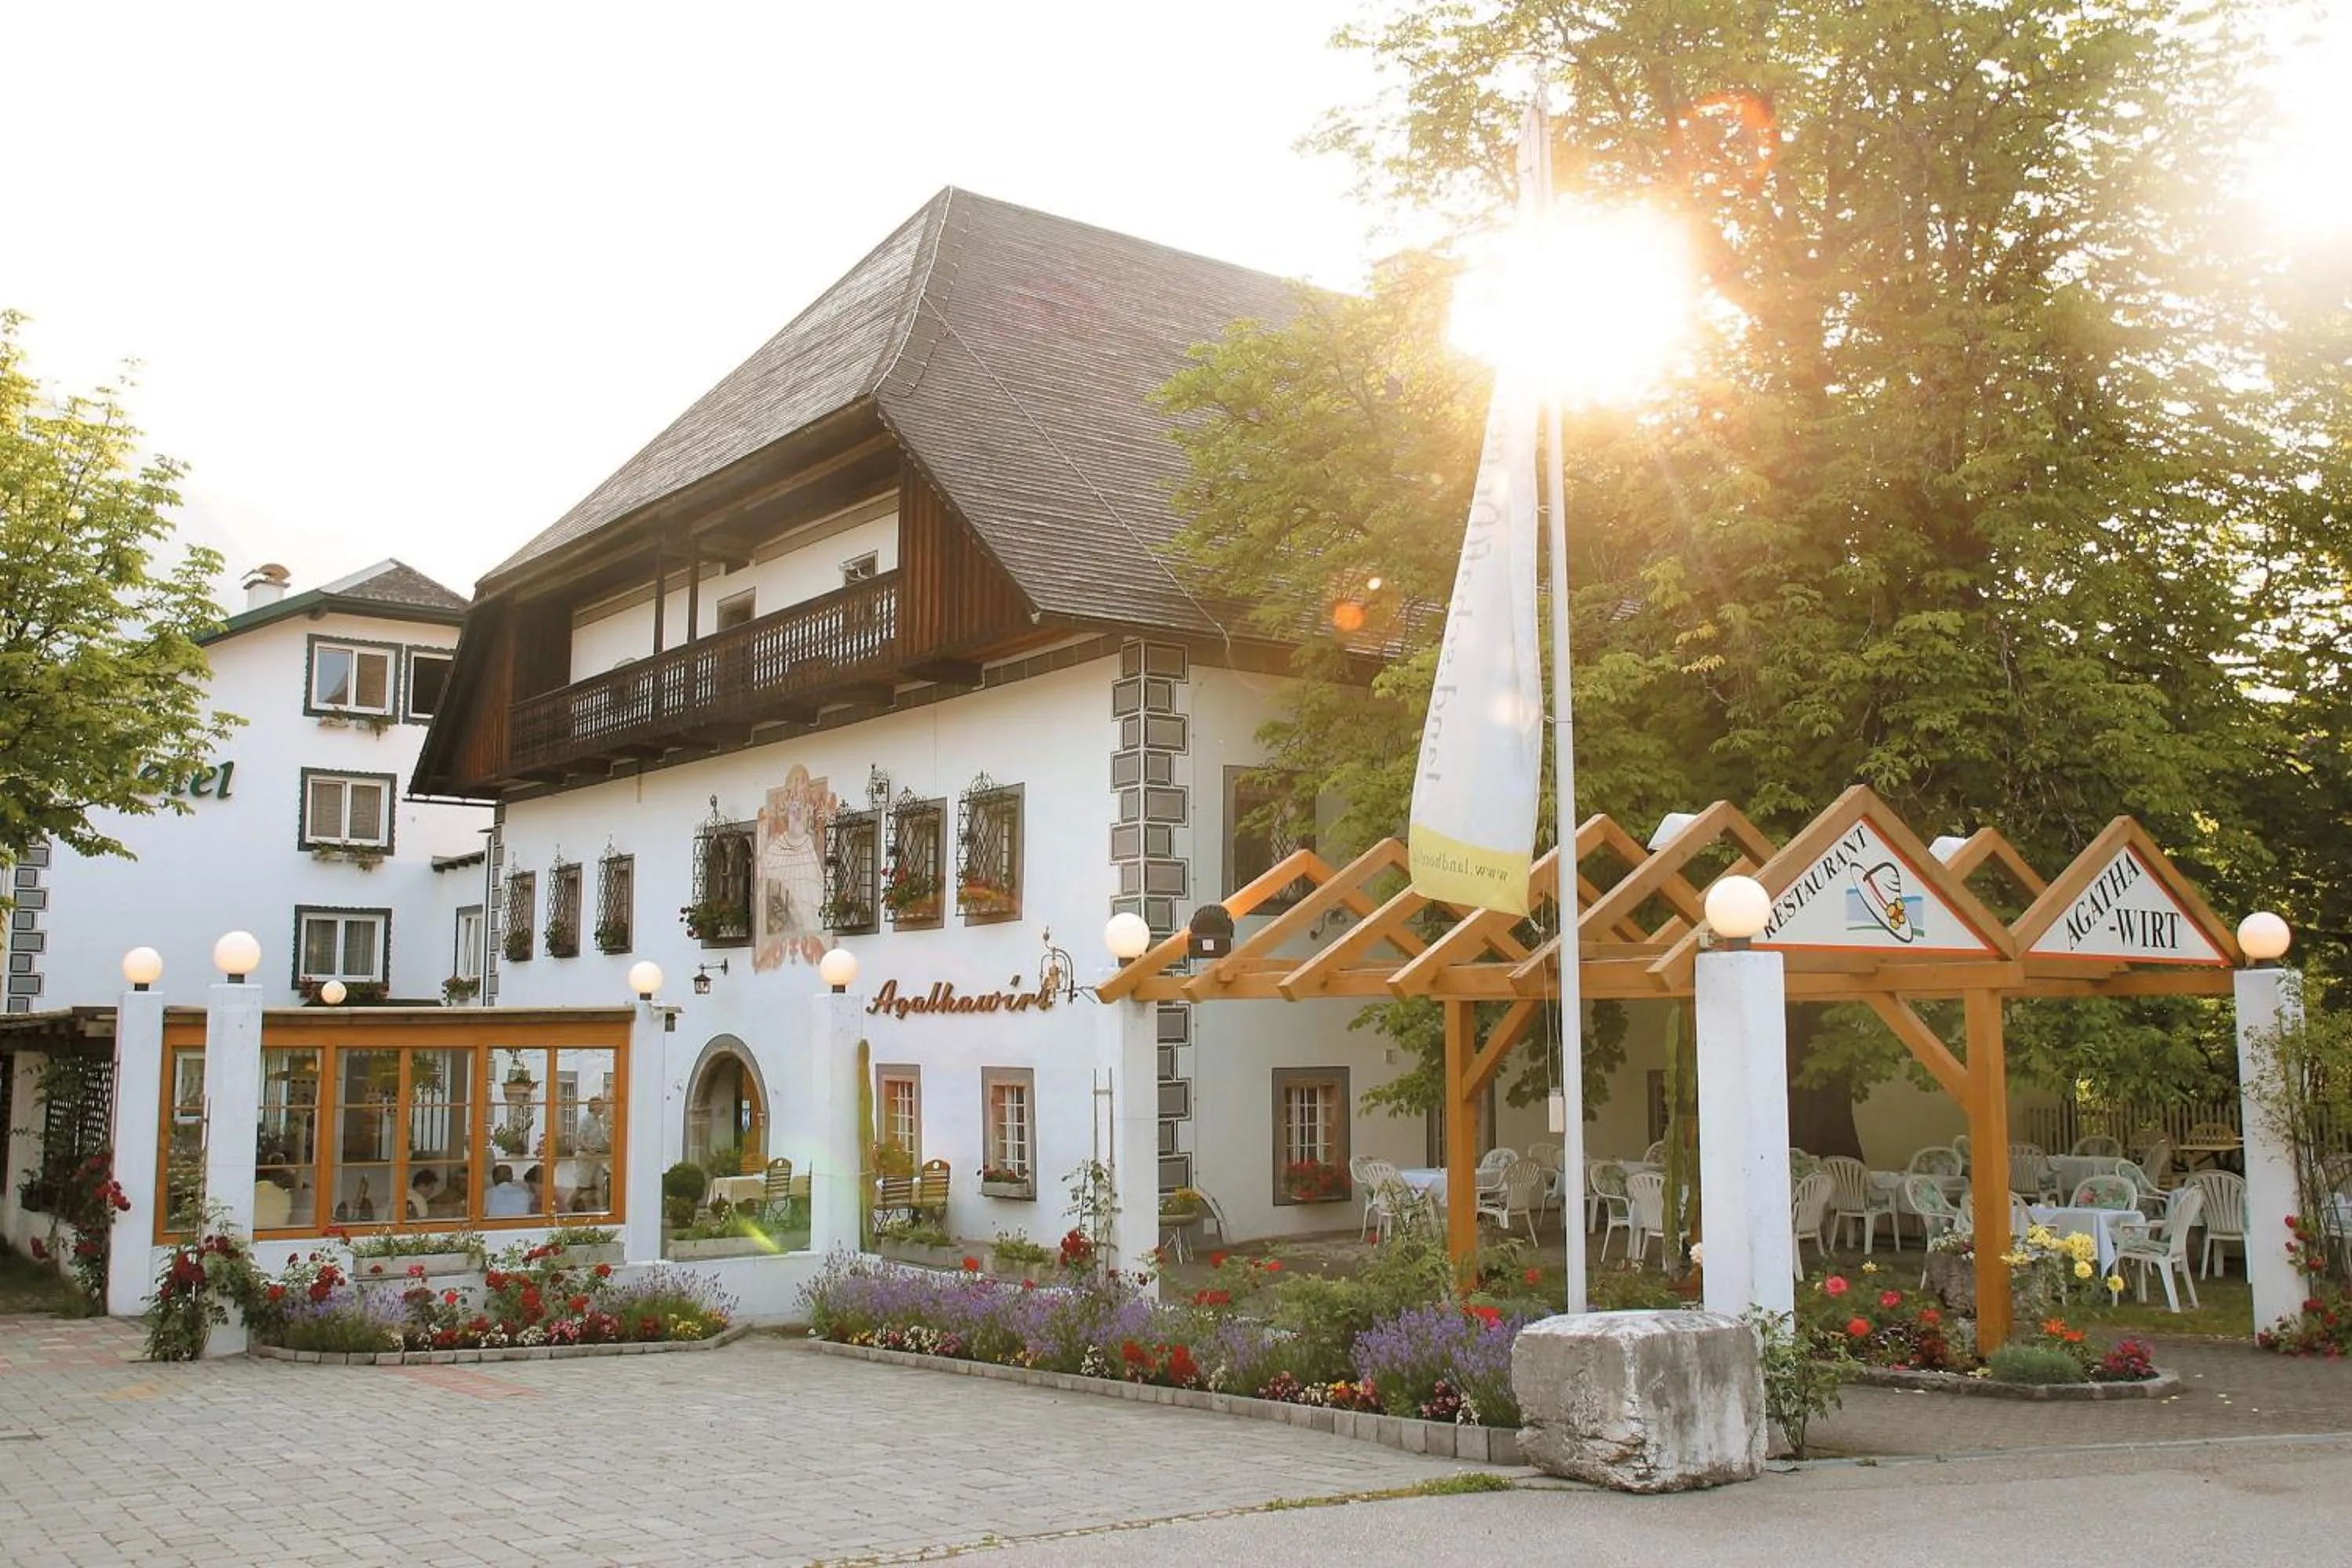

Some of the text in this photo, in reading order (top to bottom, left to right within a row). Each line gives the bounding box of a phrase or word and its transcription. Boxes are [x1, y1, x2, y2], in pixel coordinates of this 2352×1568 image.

[1763, 824, 1867, 940] RESTAURANT
[2065, 853, 2140, 951] AGATHA
[2108, 908, 2180, 949] -WIRT
[866, 975, 1053, 1020] Agathawirt
